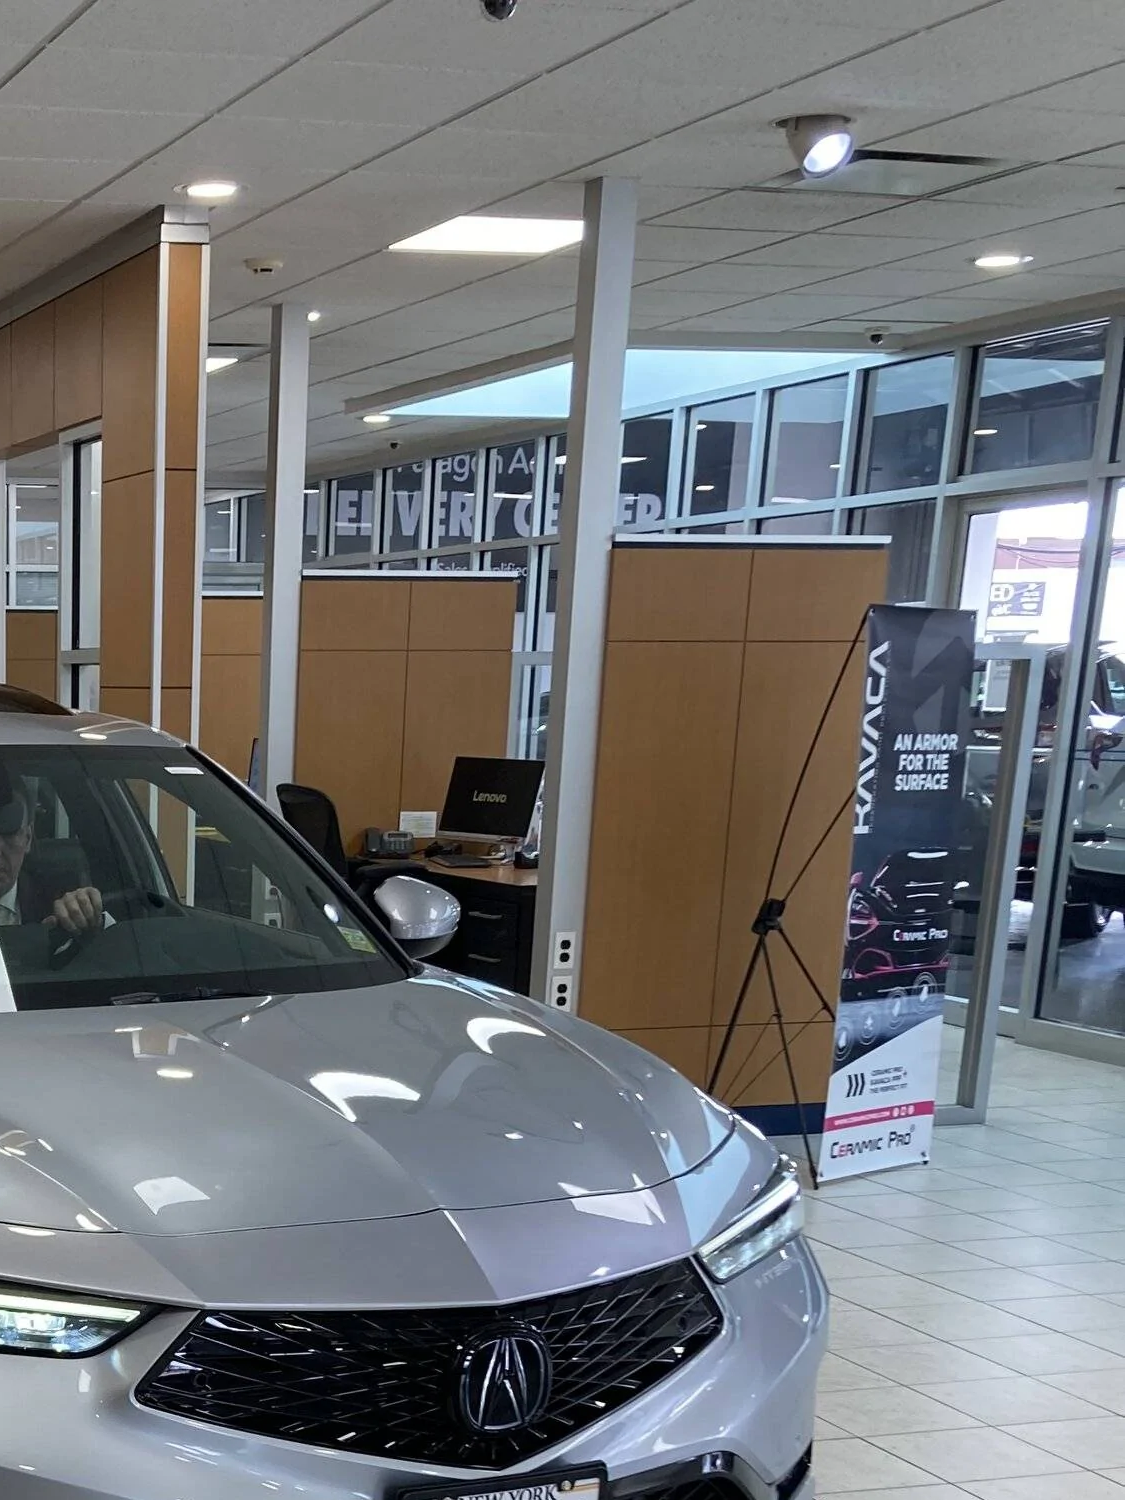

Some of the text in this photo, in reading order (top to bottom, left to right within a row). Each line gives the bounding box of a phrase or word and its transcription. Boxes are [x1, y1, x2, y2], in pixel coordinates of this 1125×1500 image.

[894, 733, 959, 751] AN ARMOR
[898, 752, 950, 771] FOR THE
[894, 773, 950, 792] SURFACE
[472, 789, 507, 803] Lenovo
